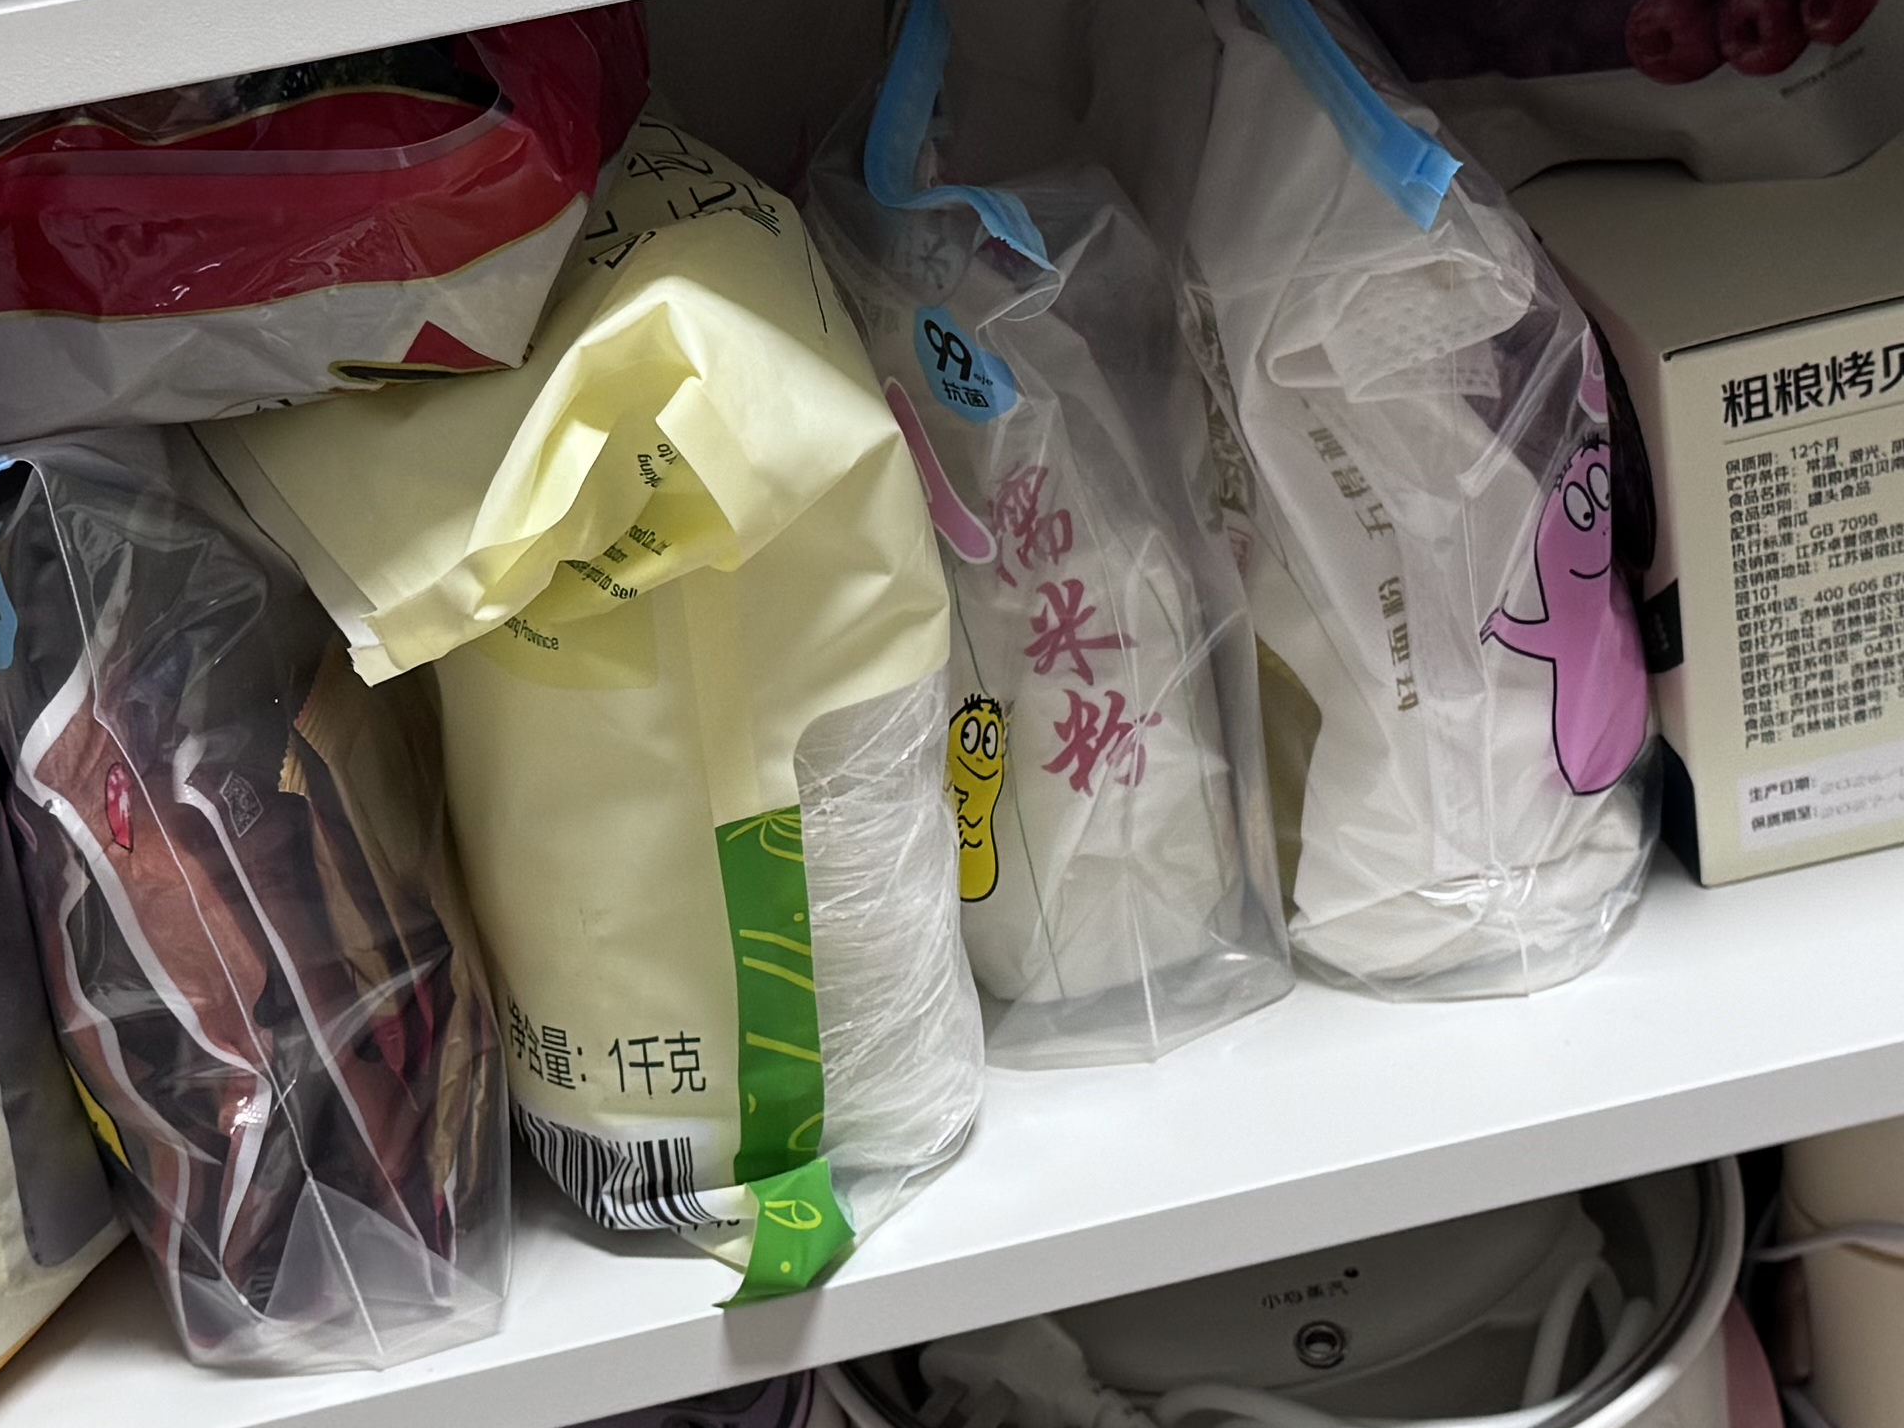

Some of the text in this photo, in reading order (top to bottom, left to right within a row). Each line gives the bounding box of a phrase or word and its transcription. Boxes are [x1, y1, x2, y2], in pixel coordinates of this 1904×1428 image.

[942, 379, 991, 410] 抗菌
[1731, 512, 1808, 542] 配料：南瓜
[1839, 512, 1879, 534] 7098
[1848, 578, 1878, 597] 606
